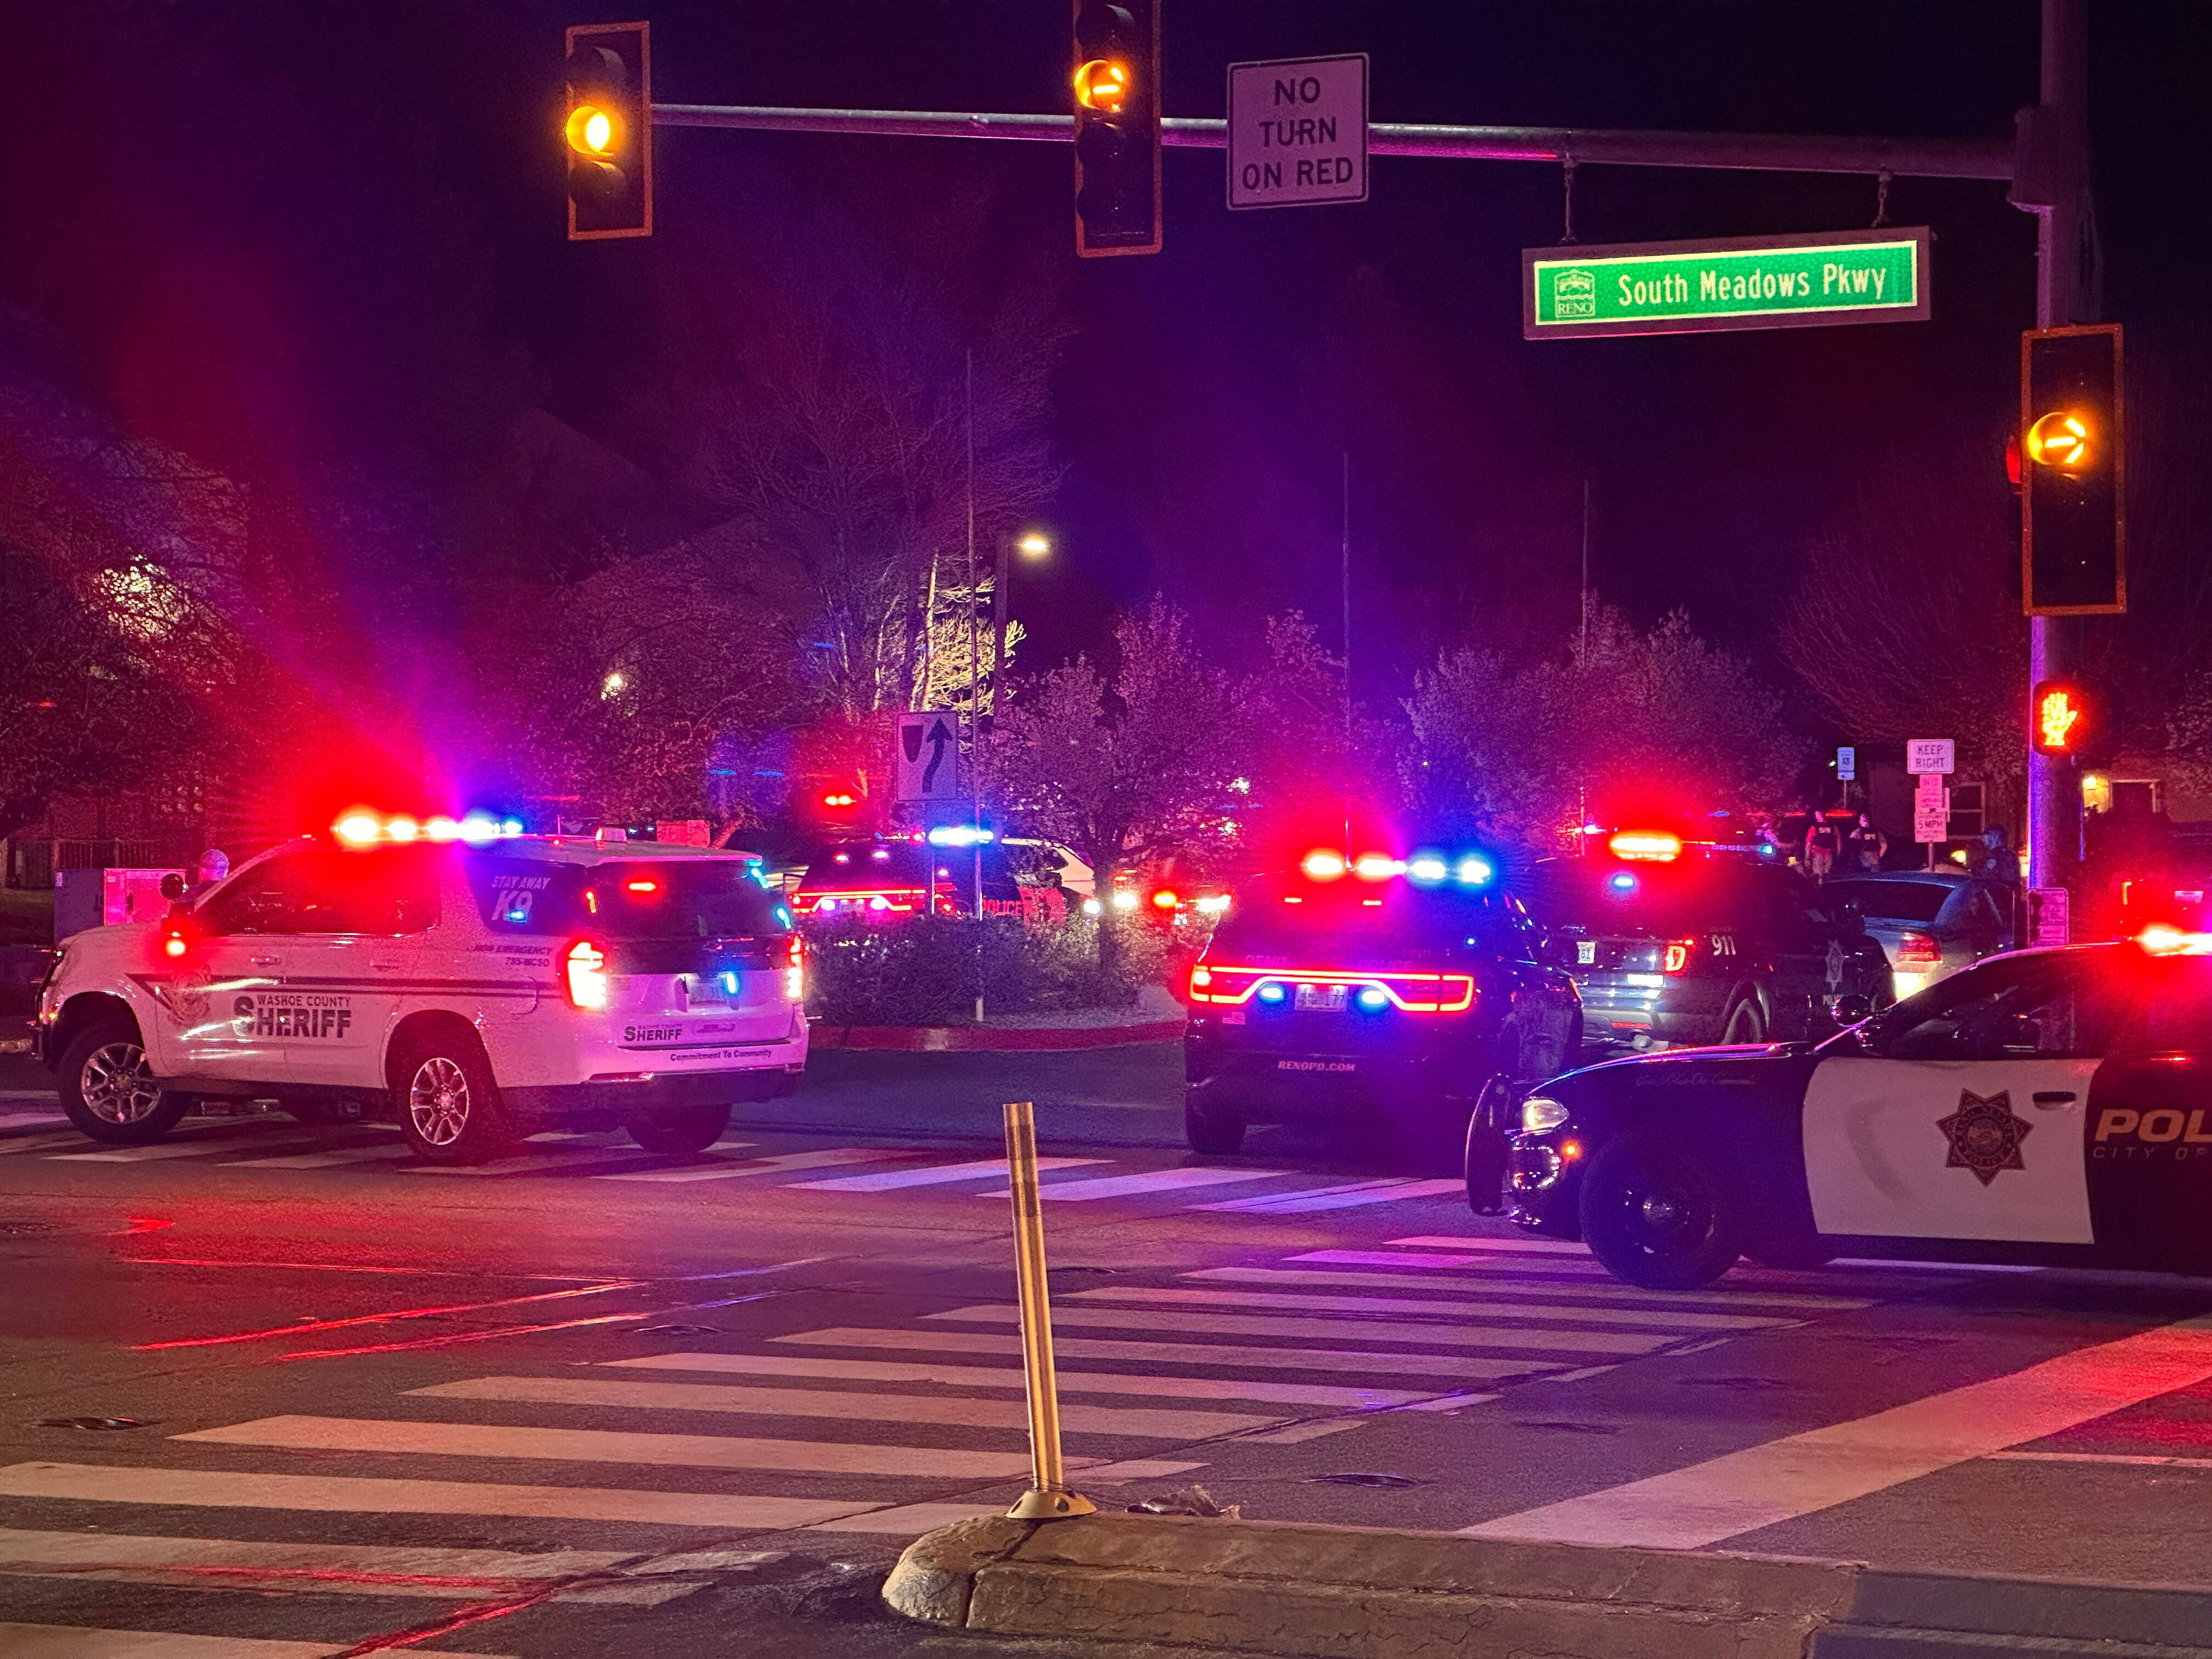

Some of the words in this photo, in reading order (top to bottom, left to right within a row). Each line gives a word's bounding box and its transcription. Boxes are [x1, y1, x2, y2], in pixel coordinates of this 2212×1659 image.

[1275, 77, 1320, 105] NO
[1259, 117, 1336, 147] TURN
[1242, 162, 1281, 190] ON
[1297, 157, 1353, 186] RED
[1619, 273, 1688, 306] South
[1700, 268, 1810, 301] Meadows
[1823, 263, 1886, 300] Pkwy
[1558, 302, 1593, 314] RENO
[1917, 744, 1944, 755] KEEP
[1915, 758, 1945, 768] RIGHT
[491, 875, 520, 888] STAY
[518, 877, 551, 890] AWAY
[491, 890, 533, 923] K9
[1712, 934, 1736, 956] 911
[257, 995, 302, 1006] WASHOE
[307, 996, 351, 1007] COUNTY
[233, 996, 351, 1038] SHERIFF
[624, 1026, 682, 1041] SHERIFF
[671, 1050, 721, 1062] Commitment
[734, 1049, 772, 1058] Community
[1278, 1060, 1356, 1072] RENOPD.COM
[2094, 1108, 2212, 1142] POL
[2093, 1146, 2155, 1159] CITY
[2175, 1147, 2208, 1161] OF
